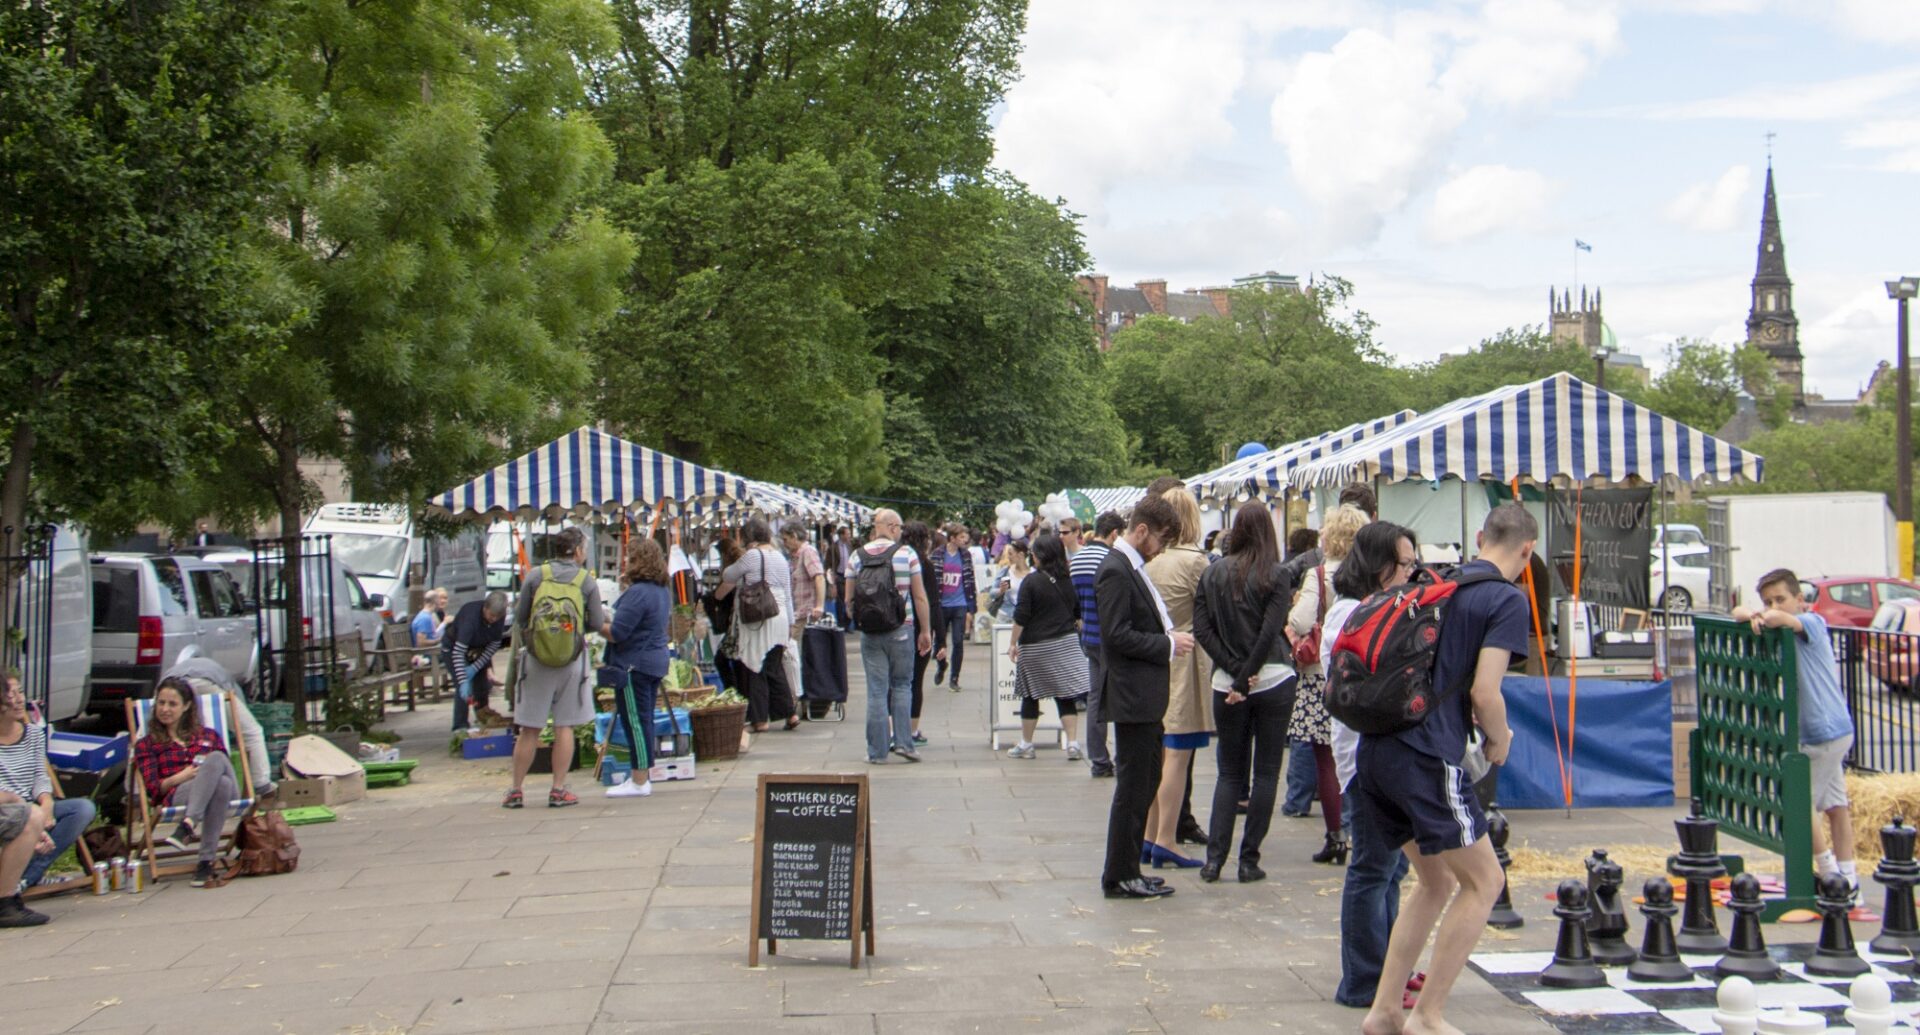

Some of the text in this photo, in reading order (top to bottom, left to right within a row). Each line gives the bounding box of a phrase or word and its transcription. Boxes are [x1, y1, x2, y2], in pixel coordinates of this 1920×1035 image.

[1555, 501, 1650, 530] NOTHERN EDGE
[770, 791, 857, 807] NORTHERN EDGE
[792, 805, 837, 817] COFFEE
